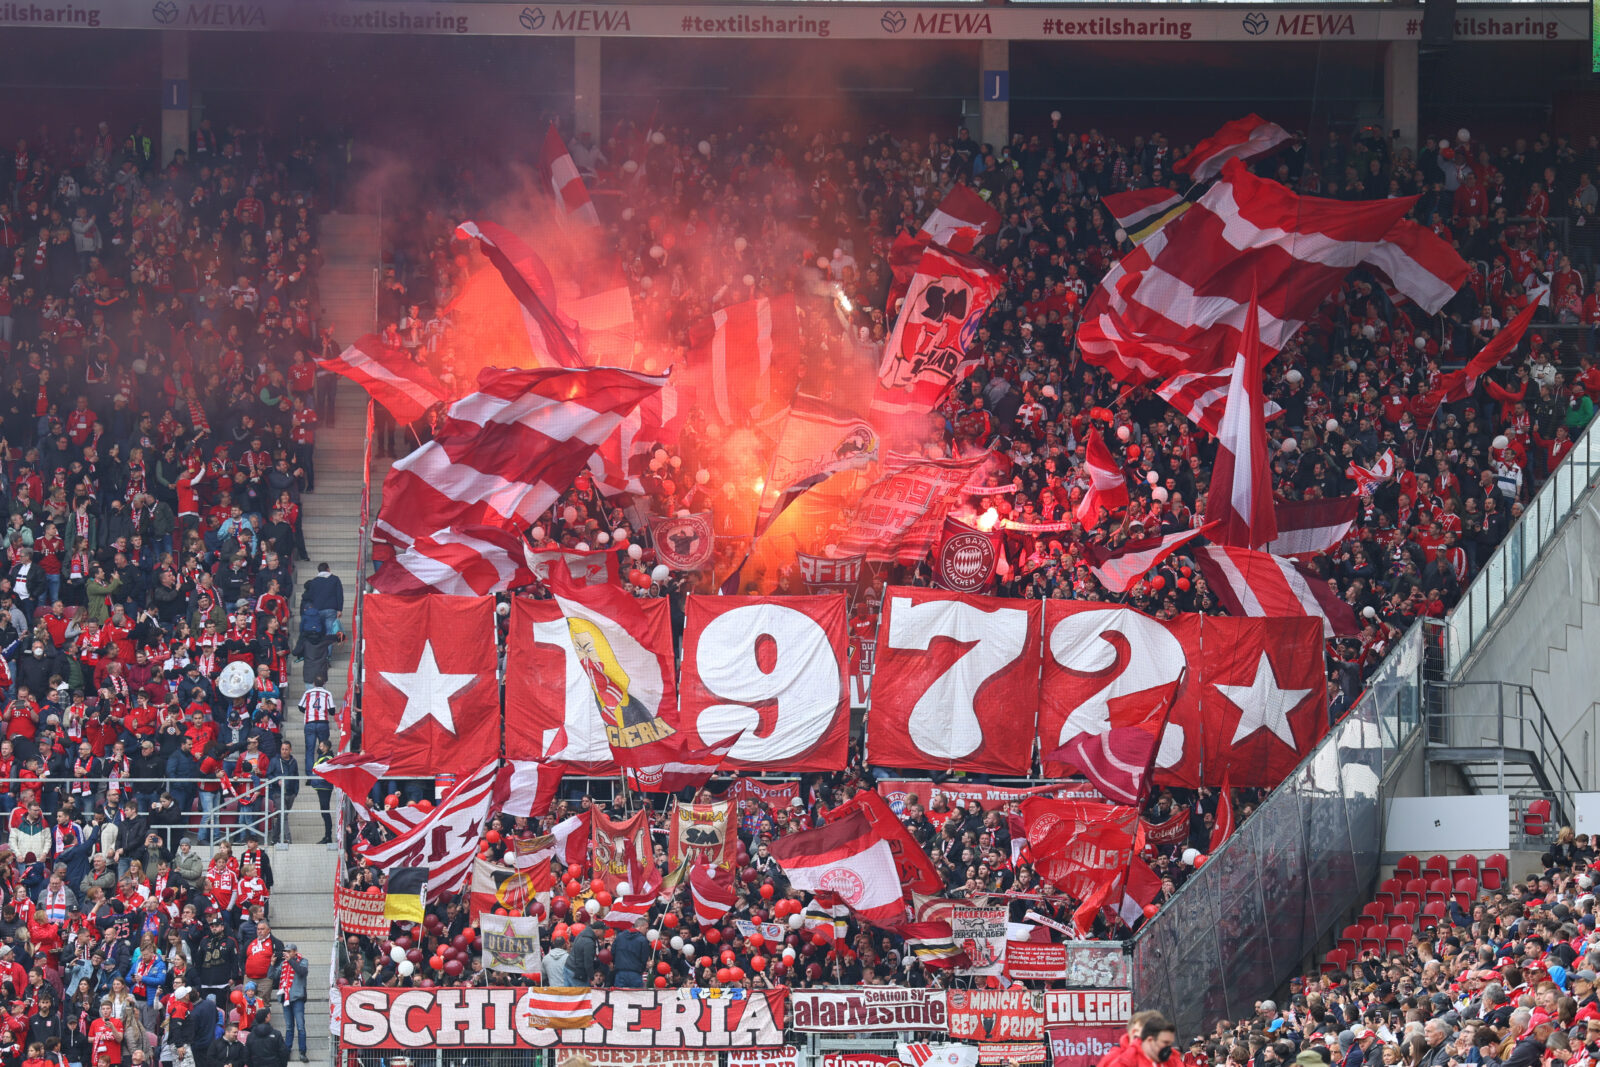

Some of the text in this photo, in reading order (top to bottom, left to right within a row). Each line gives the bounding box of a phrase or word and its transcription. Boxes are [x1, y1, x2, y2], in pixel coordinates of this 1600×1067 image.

[185, 7, 267, 26] MEWA
[319, 11, 468, 33] #textilsharing
[551, 11, 631, 31] MEWA
[681, 15, 831, 37] #textilsharing
[914, 13, 992, 34] MEWA
[1276, 14, 1355, 35] MEWA
[1042, 17, 1193, 40] #textilsharing
[313, 697, 321, 711] 4
[488, 934, 530, 953] ULTRAS
[865, 989, 925, 1003] Sektion SV
[969, 990, 1031, 1011] MUNICH'S
[1045, 993, 1132, 1022] COLEGIO
[951, 1012, 1045, 1040] RED PRIDE
[731, 1046, 798, 1061] WIR SIND
